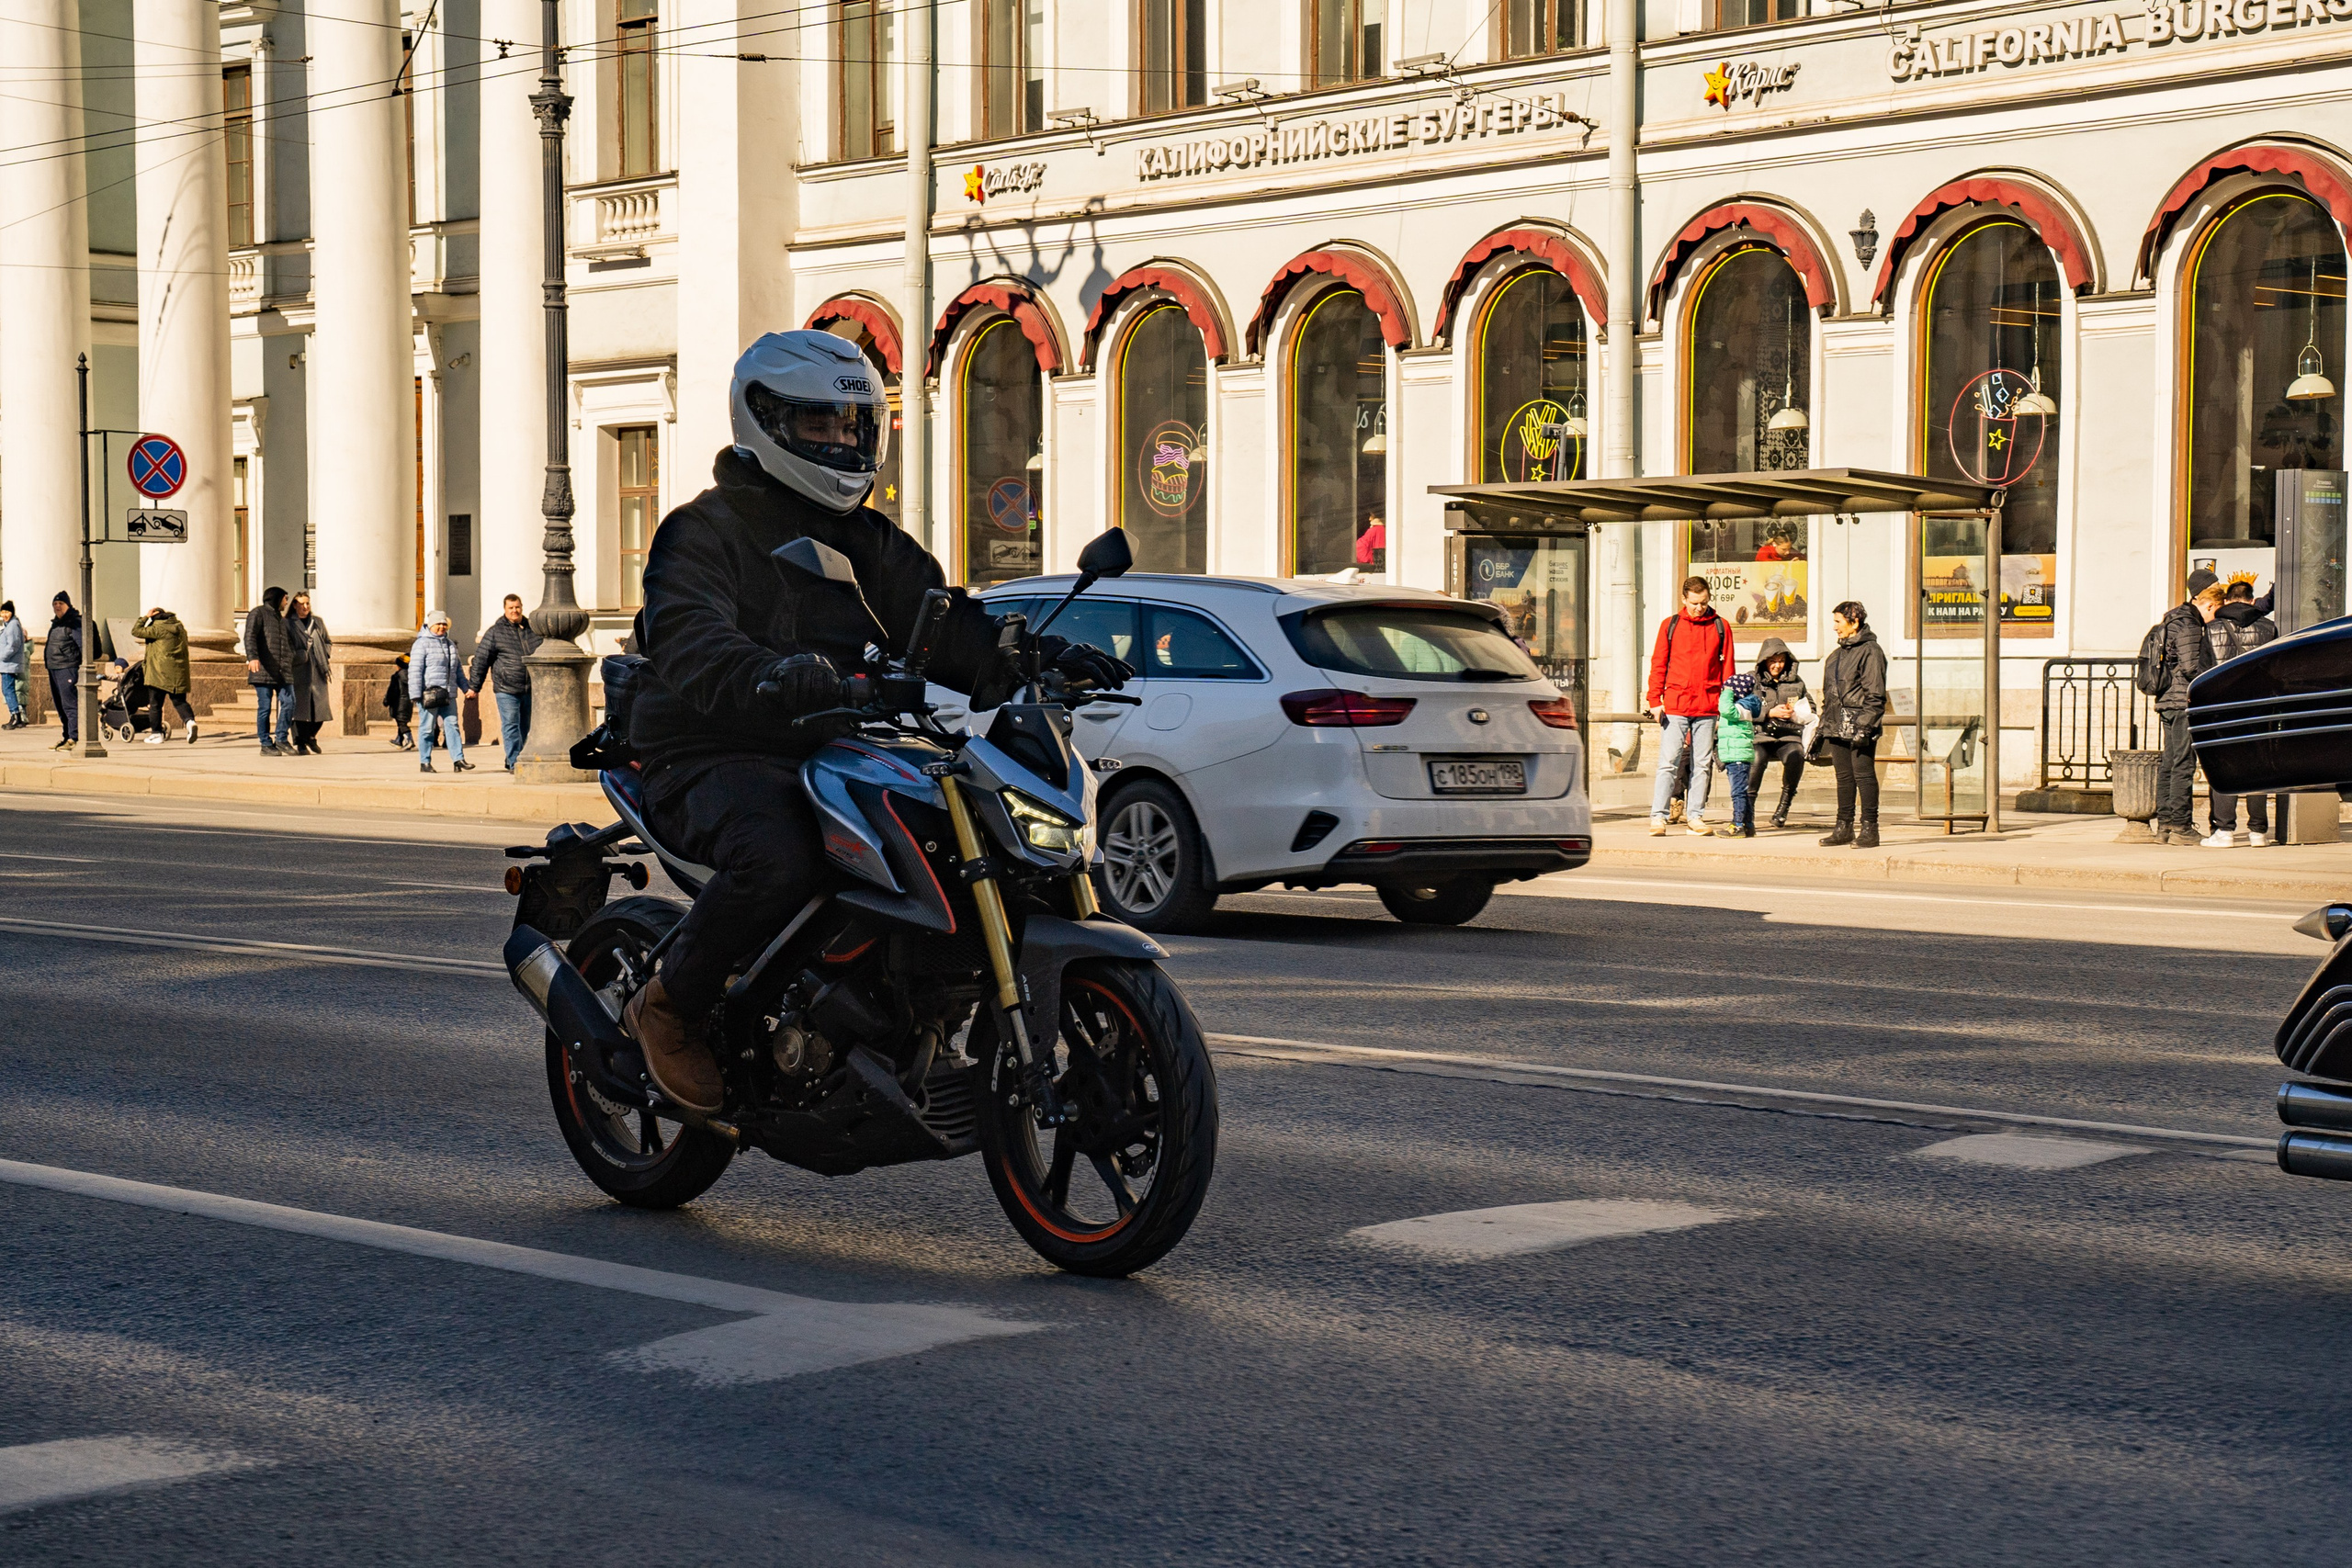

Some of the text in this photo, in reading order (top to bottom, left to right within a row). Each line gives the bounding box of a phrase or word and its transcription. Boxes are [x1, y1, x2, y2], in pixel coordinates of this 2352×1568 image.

[1886, 14, 2126, 79] CALIFORNIA
[1135, 93, 1564, 176] КАЛИФОРНИЙСКИЕ БУРГЕРЫ
[840, 378, 871, 393] SHOEI
[1495, 562, 1510, 570] ББР
[1705, 566, 1742, 575] АРОМАТНЫЙ
[1495, 570, 1514, 579] БАНК
[1706, 576, 1741, 590] КОФЕ
[1928, 606, 2008, 616] К НАМ НА РАУ
